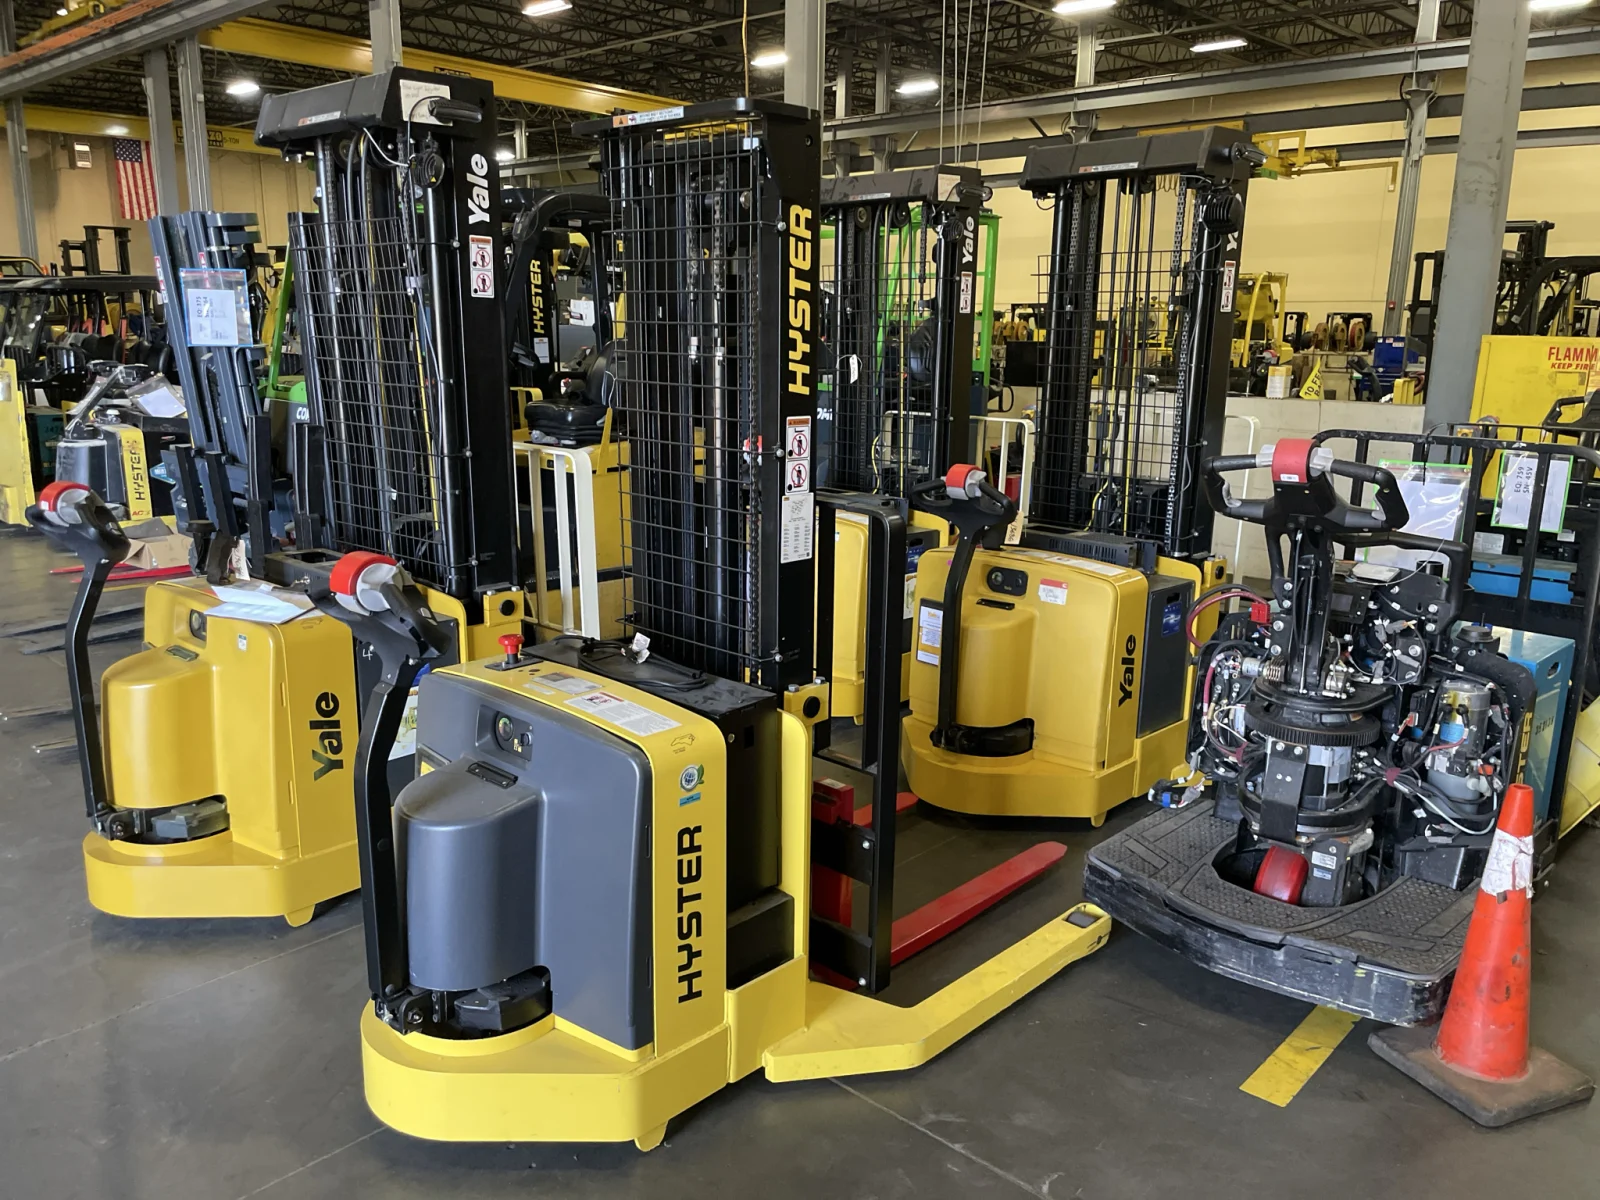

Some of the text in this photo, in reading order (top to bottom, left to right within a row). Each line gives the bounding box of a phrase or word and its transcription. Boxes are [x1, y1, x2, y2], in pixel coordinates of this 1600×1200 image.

[466, 153, 491, 225] Yale
[962, 216, 975, 264] Yale
[529, 259, 545, 334] HYSTER
[788, 203, 813, 396] HYSTER
[1304, 386, 1315, 397] 10
[1550, 362, 1596, 371] KEEP FIRE
[1516, 466, 1525, 479] 759
[362, 648, 373, 661] 4
[1118, 634, 1137, 708] Yale
[309, 691, 344, 782] Yale
[677, 824, 702, 1004] HYSTER
